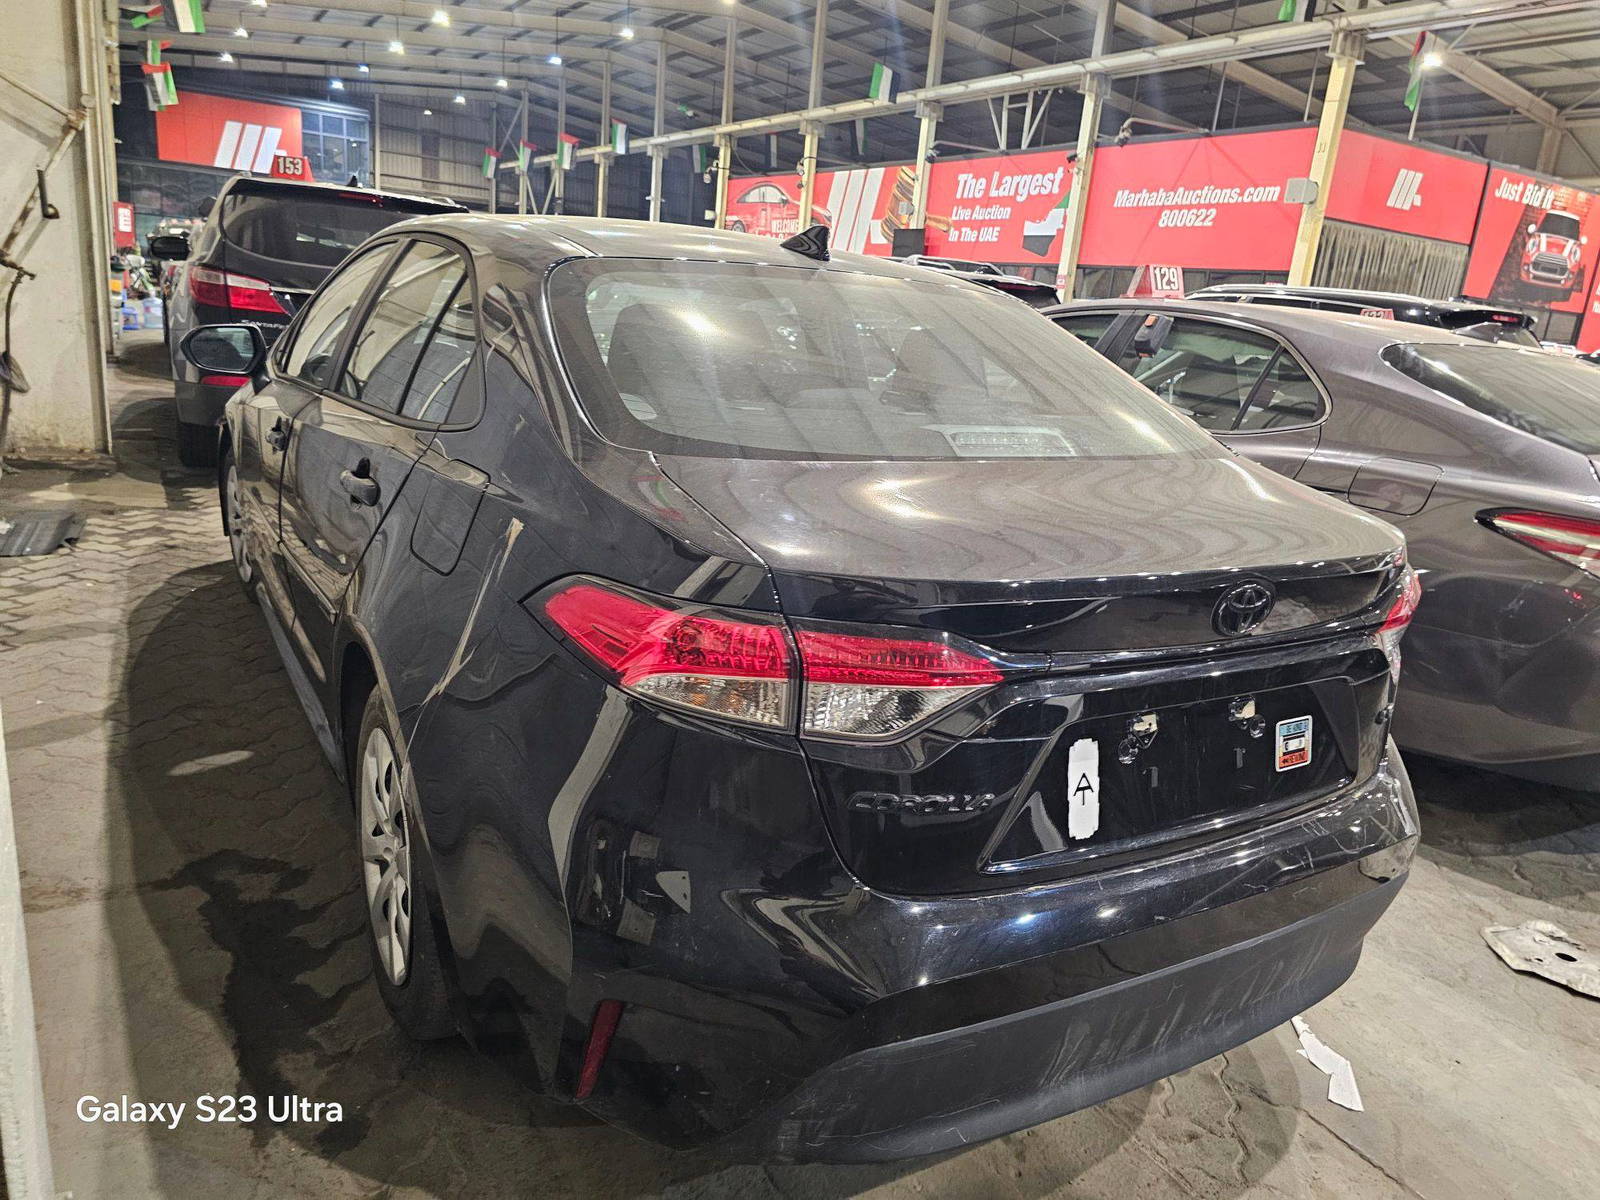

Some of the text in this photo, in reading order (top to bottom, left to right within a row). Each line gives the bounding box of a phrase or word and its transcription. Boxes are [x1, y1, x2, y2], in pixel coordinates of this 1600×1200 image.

[278, 157, 302, 175] 153
[956, 166, 1064, 202] The Largest
[1495, 177, 1524, 202] Just
[1522, 183, 1546, 208] Bid
[1113, 185, 1281, 208] MarhabaAuctions.com
[952, 205, 1011, 220] Live Auction
[1158, 208, 1217, 227] 800622
[948, 226, 1001, 242] In The UAE
[1154, 266, 1179, 290] 129
